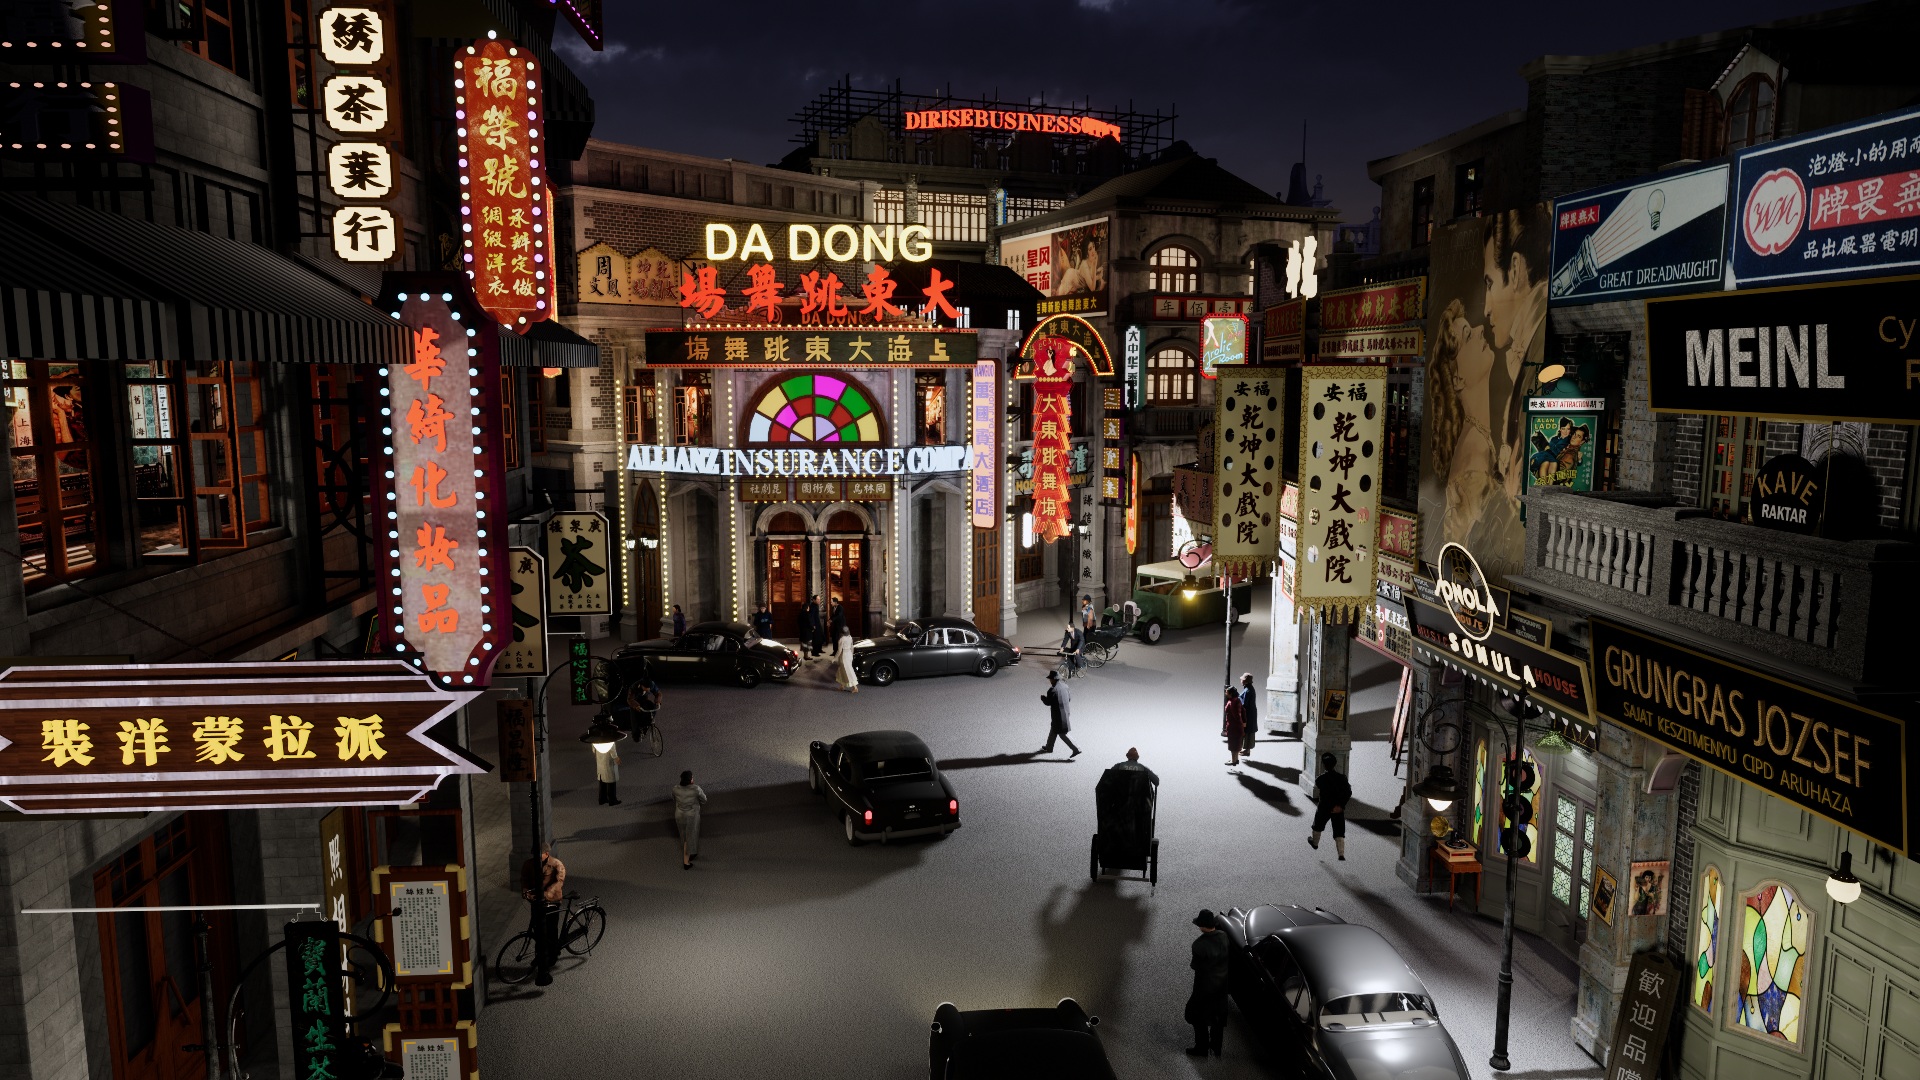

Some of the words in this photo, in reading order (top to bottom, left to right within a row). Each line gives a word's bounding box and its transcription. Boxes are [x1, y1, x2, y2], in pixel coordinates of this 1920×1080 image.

[474, 57, 527, 199] 福榮號
[705, 223, 773, 262] DA
[789, 223, 933, 262] DONG
[1600, 270, 1633, 288] GREAT
[1636, 259, 1717, 285] DREADNAUGHT
[1219, 353, 1243, 363] Room
[1686, 323, 1846, 389] MEINL
[1324, 383, 1368, 402] 福安
[720, 449, 904, 476] INSURANCE
[1757, 471, 1818, 506] KAVE
[1762, 503, 1807, 524] RAKTAR
[552, 535, 606, 594] 茶
[1535, 668, 1578, 699] HOUSE
[1605, 645, 1746, 738] GRUNGRAS
[1754, 700, 1873, 788] JOZSEF
[41, 714, 388, 767] 派拉蒙洋裝
[1623, 702, 1653, 727] SAJAT
[1658, 715, 1738, 764] KESZITMENYU
[1742, 754, 1773, 779] CIPD
[1780, 772, 1853, 817] ARUHAZA
